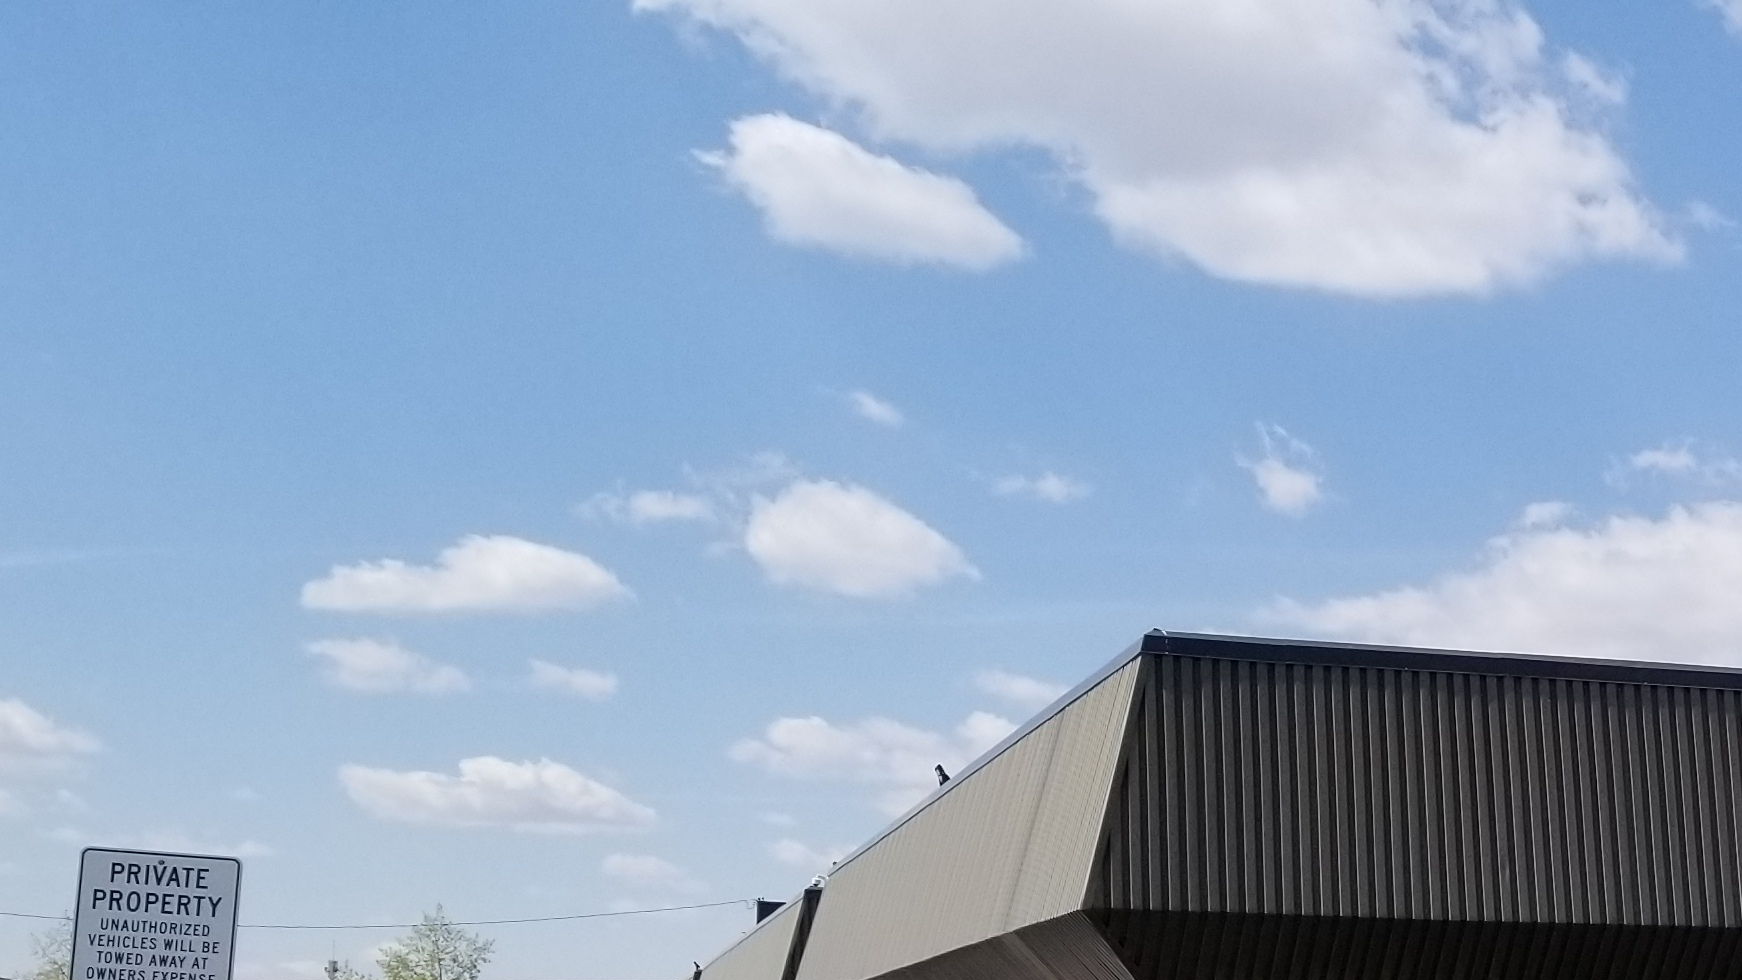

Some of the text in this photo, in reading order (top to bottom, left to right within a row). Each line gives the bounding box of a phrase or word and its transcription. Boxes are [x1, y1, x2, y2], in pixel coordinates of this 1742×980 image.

[110, 862, 210, 890] PRIVATE
[92, 888, 222, 918] PROPERTY
[100, 918, 210, 937] UNAUTHORIZED
[88, 934, 220, 954] VEHICLES WILL BE
[96, 950, 209, 970] TOWED AWAY AT
